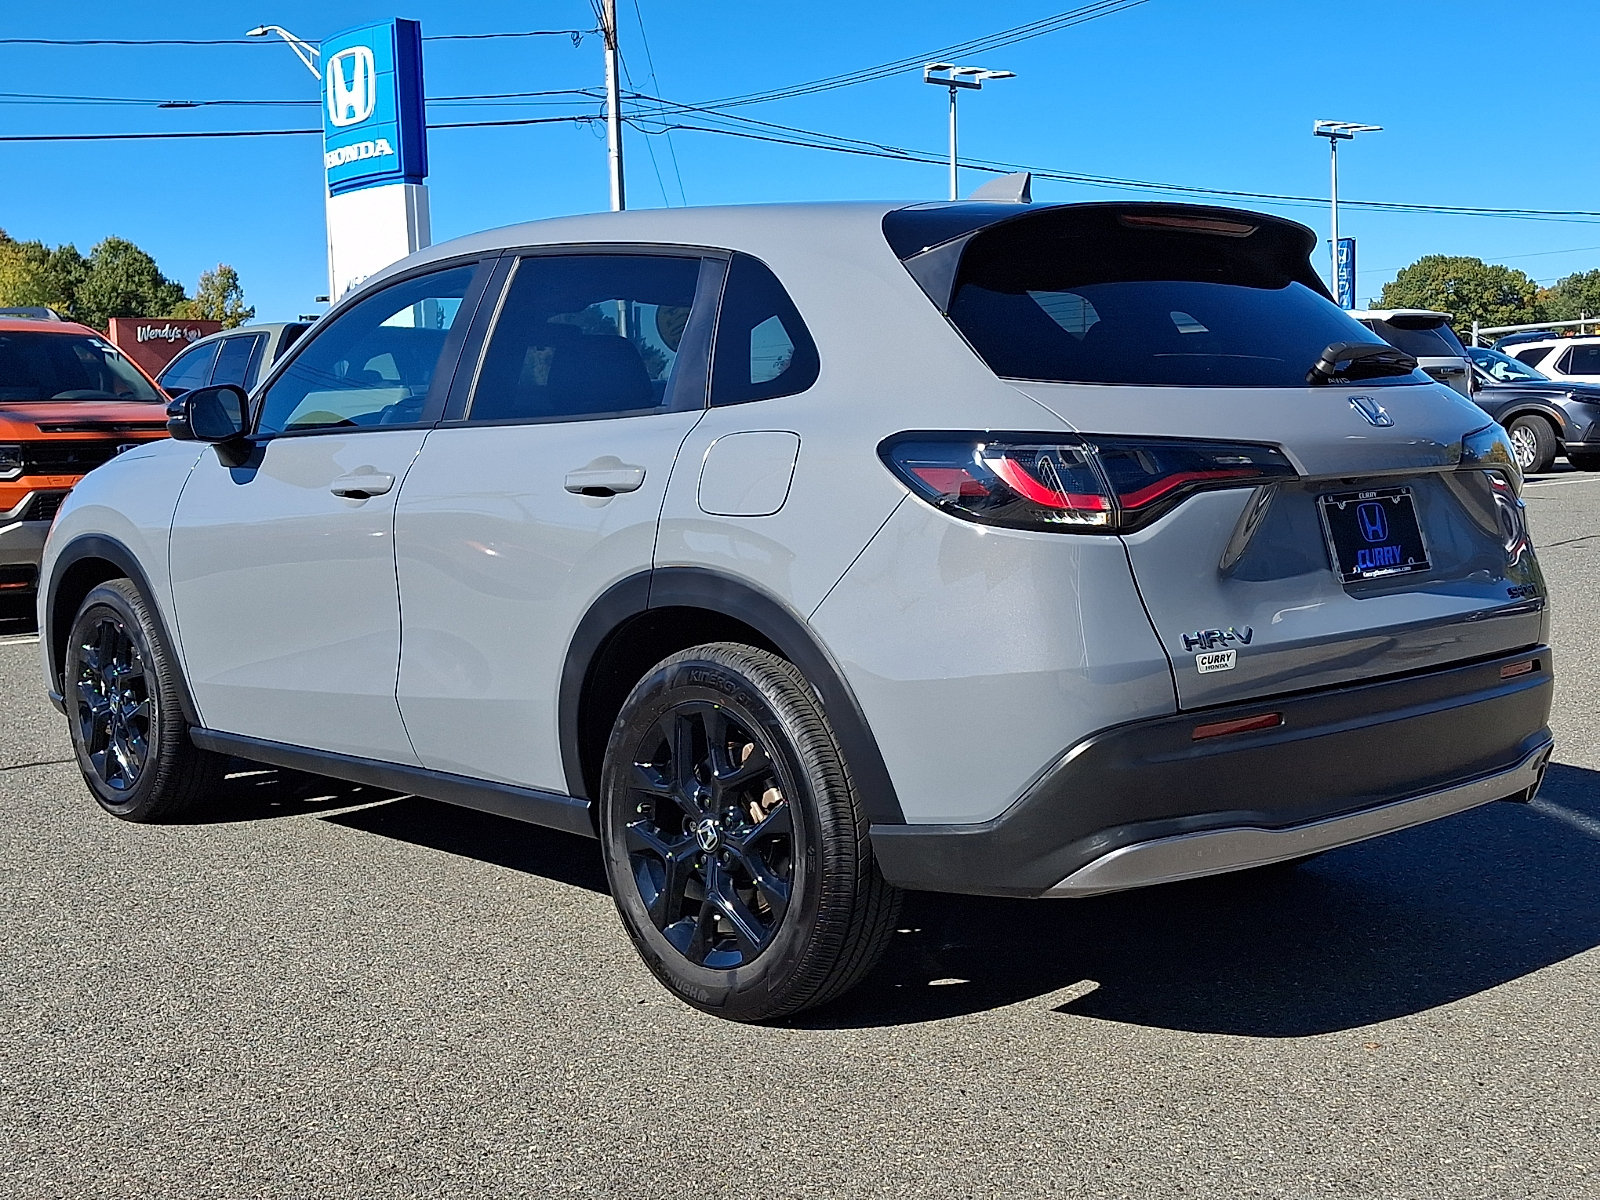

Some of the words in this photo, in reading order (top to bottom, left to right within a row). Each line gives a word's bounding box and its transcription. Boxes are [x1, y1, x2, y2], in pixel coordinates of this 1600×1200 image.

[325, 138, 394, 170] HONDA
[137, 323, 182, 343] Wendy's
[1357, 545, 1402, 569] CURRY
[1180, 624, 1254, 652] HR-V
[1200, 652, 1232, 666] CURRY
[1205, 662, 1229, 671] HONDA
